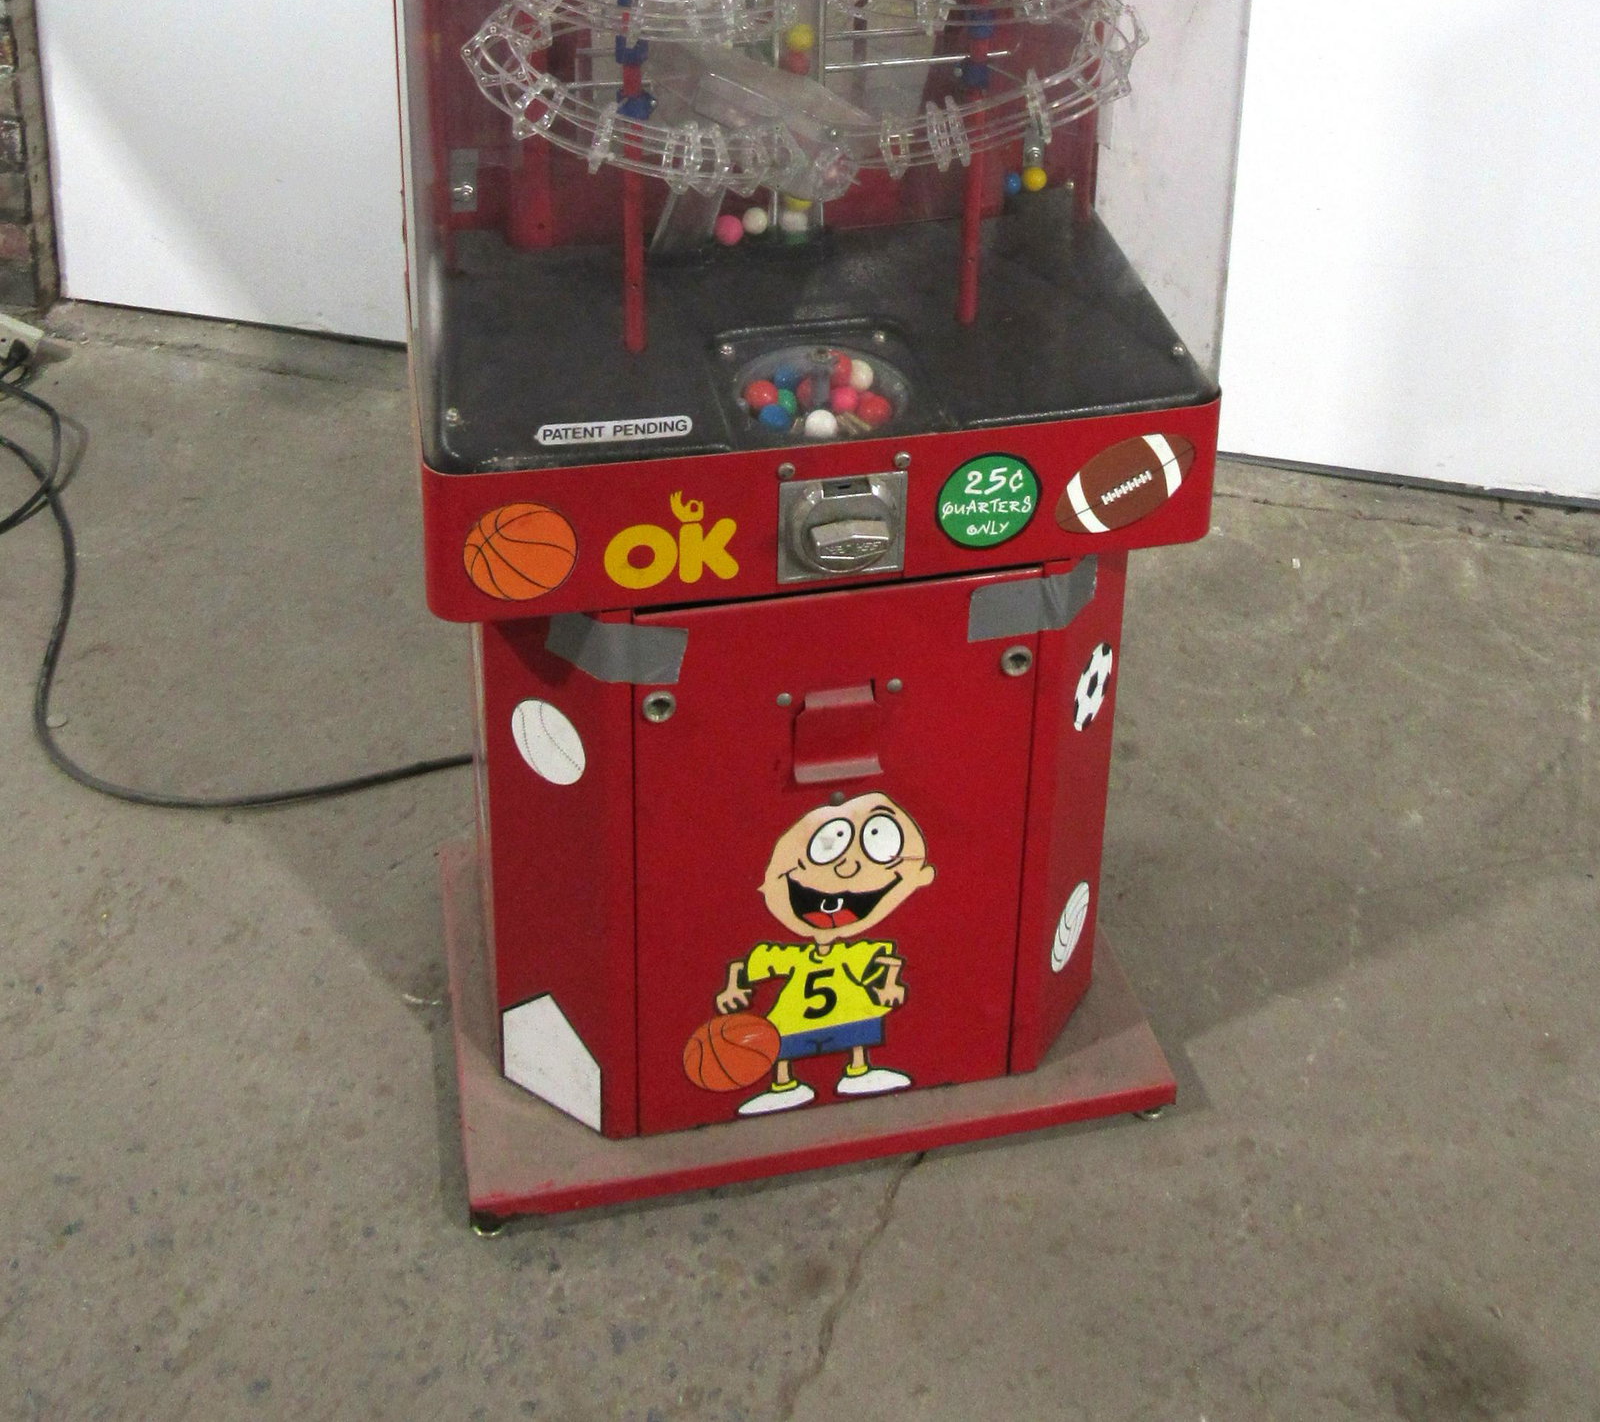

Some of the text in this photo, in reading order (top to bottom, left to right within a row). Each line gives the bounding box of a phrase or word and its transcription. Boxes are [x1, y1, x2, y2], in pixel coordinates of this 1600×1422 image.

[542, 418, 689, 442] PATENT PENDING
[963, 466, 1025, 496] 25¢
[941, 495, 1032, 520] QUARTERS
[966, 520, 1010, 536] ONLY
[603, 517, 740, 590] OK
[802, 968, 838, 1020] 5
